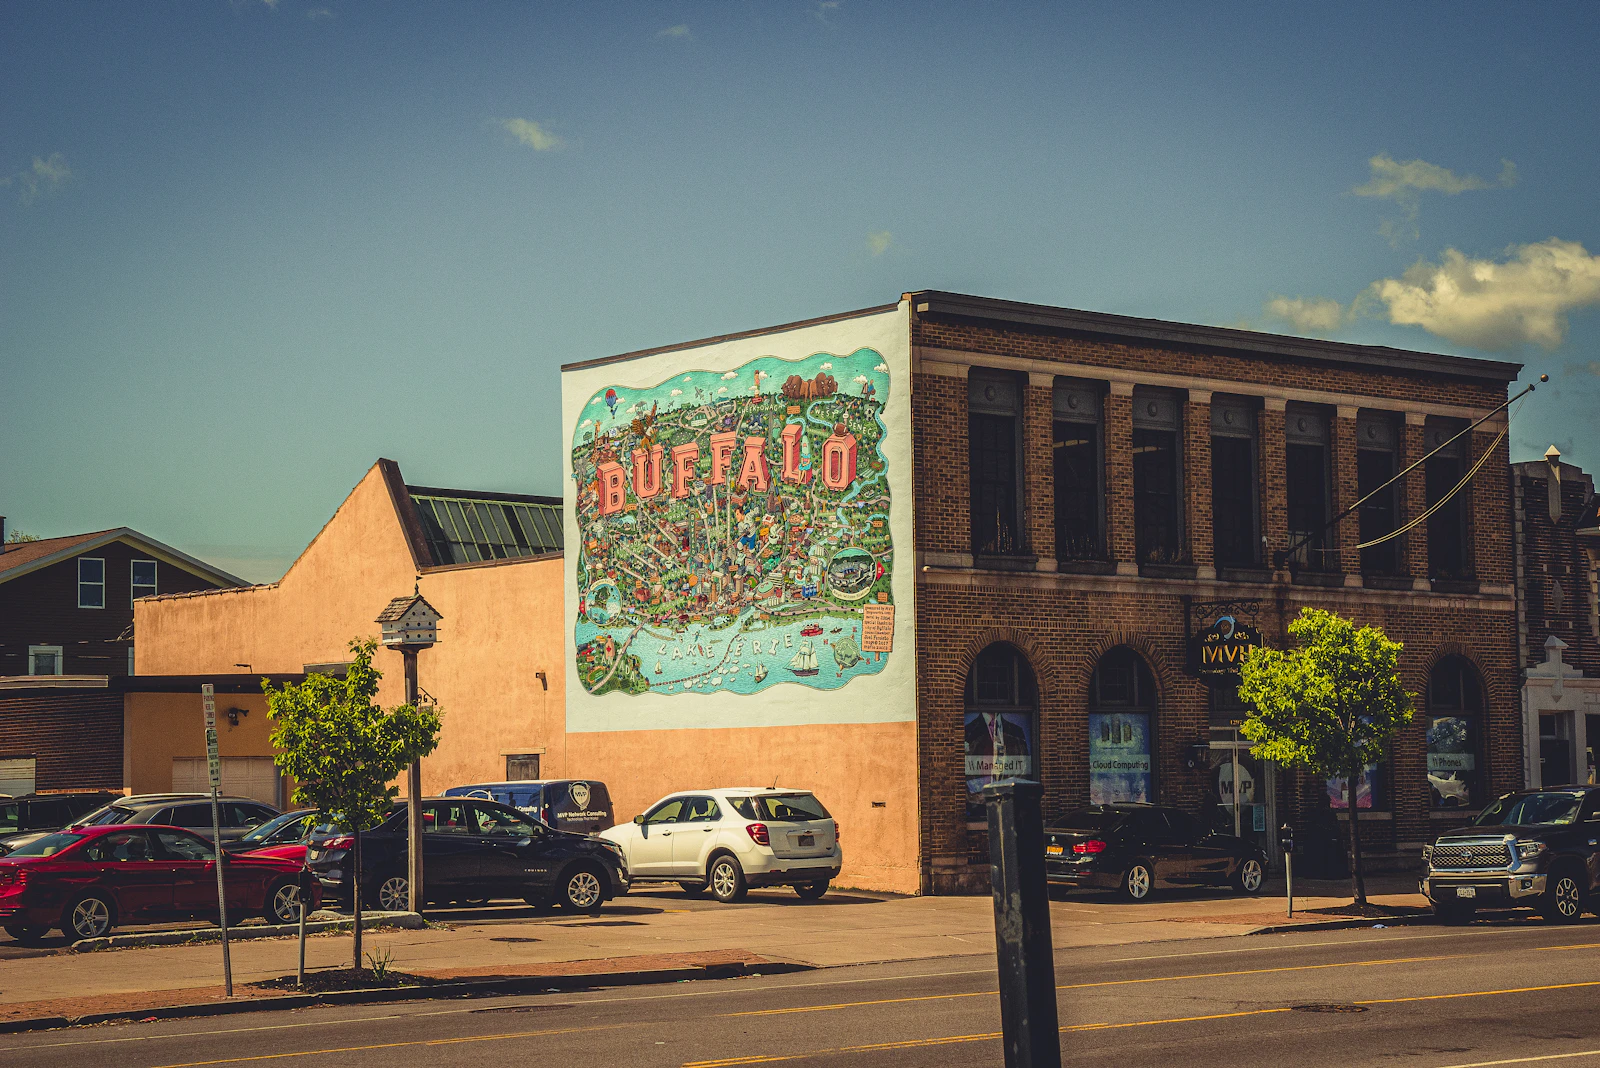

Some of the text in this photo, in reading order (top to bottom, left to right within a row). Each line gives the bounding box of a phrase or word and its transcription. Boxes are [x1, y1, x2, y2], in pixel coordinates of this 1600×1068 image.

[738, 400, 783, 414] CHEEKTOWAGA
[815, 408, 838, 419] WEST
[849, 419, 877, 438] SENECA
[596, 423, 857, 518] BUFFALO
[657, 633, 793, 660] LAKE ERIE
[594, 655, 635, 682] CANADA
[976, 760, 1014, 773] Managed
[1015, 760, 1023, 770] IT
[1093, 759, 1149, 772] Cloud Computing
[1439, 757, 1462, 767] Phones
[517, 805, 538, 813] Consulting
[587, 810, 607, 818] Consulting
